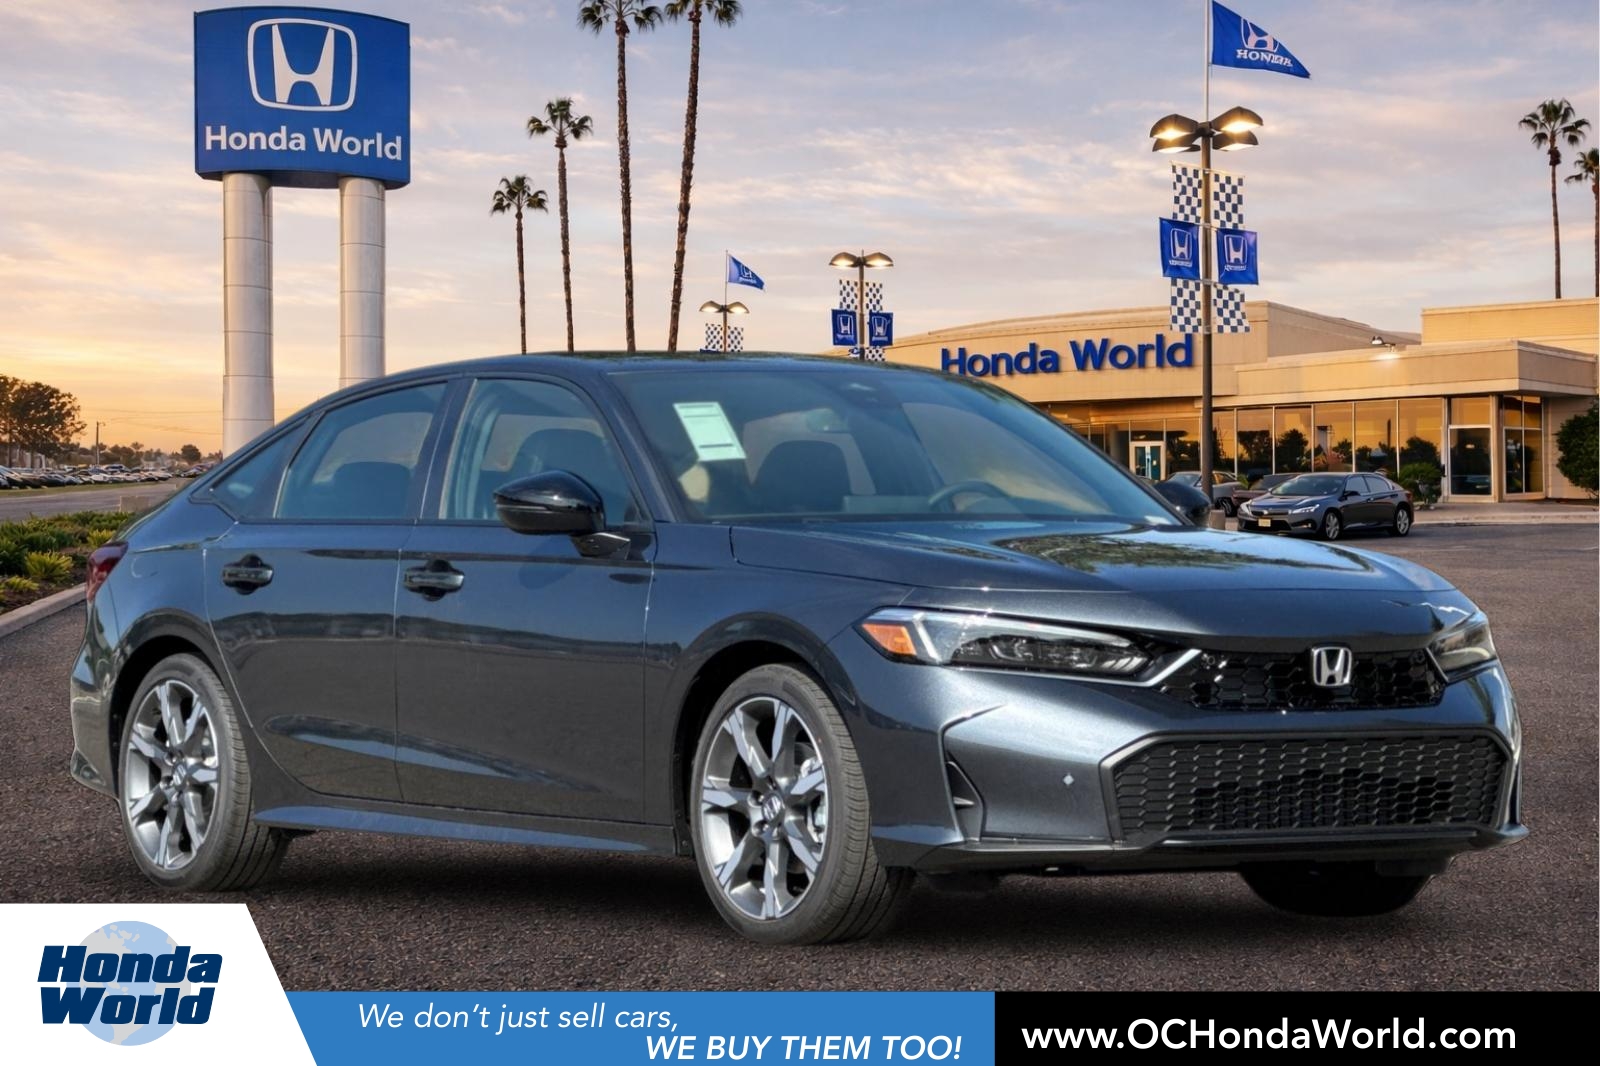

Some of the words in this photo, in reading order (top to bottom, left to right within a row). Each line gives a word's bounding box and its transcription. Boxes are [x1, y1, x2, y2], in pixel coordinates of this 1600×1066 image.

[205, 125, 306, 151] Honda
[313, 127, 402, 161] World
[941, 342, 1061, 377] Honda
[1069, 333, 1194, 371] World
